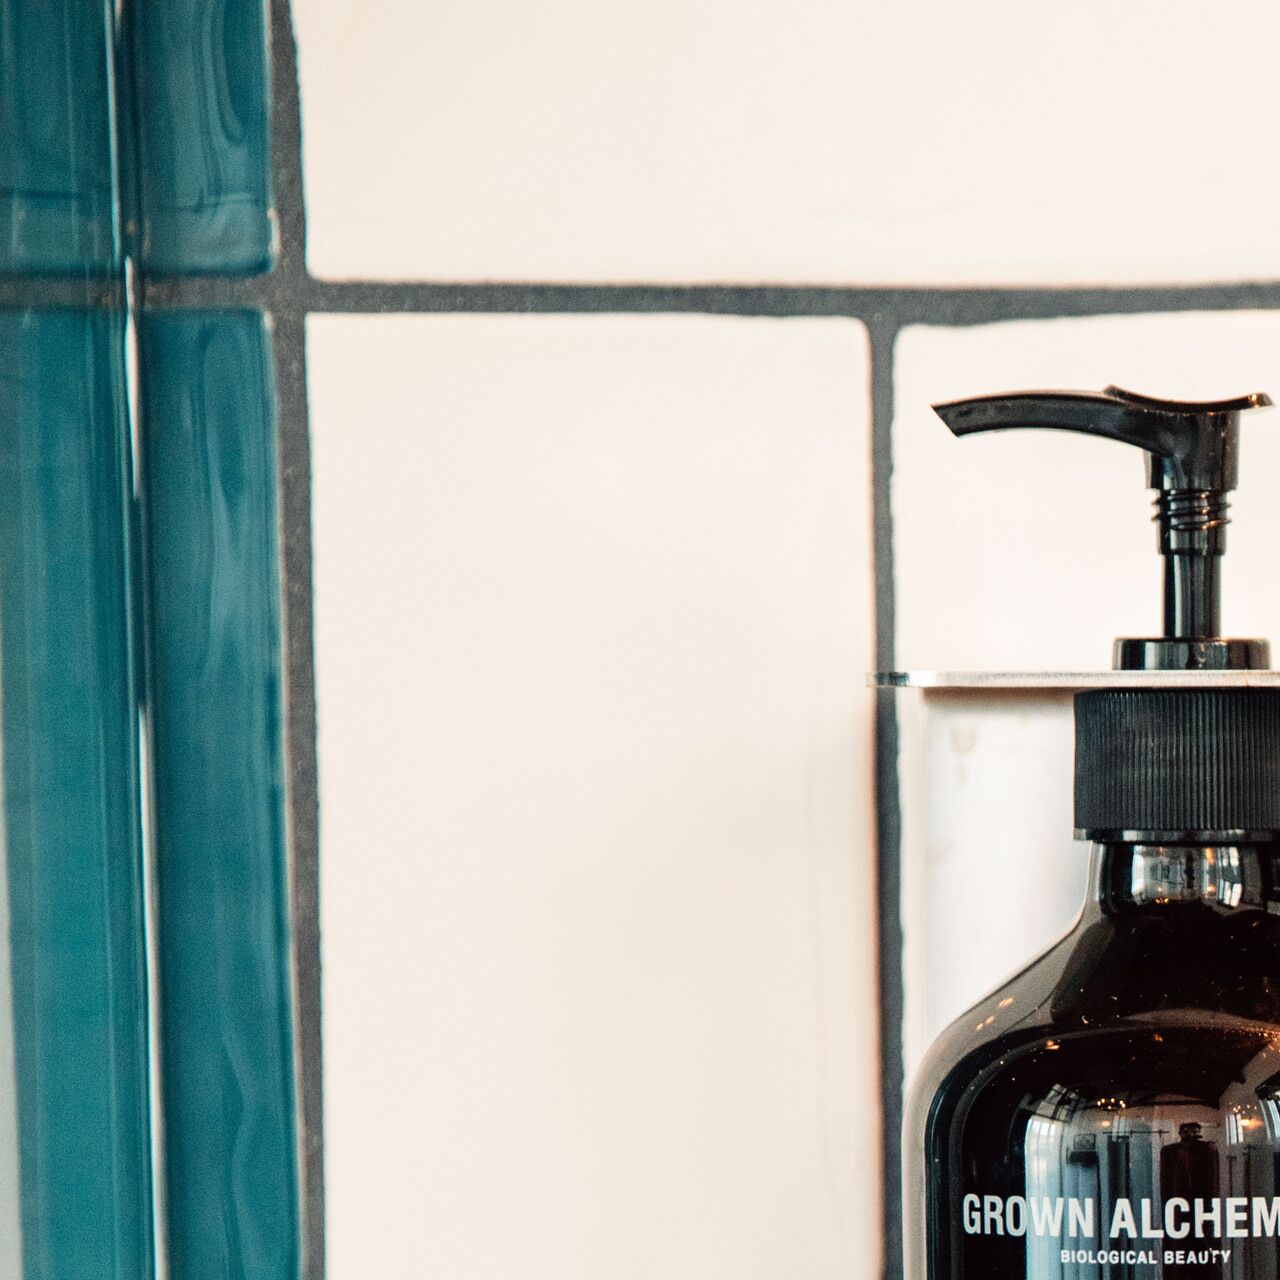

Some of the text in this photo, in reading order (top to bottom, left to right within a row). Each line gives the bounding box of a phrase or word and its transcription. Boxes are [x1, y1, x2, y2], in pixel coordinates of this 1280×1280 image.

[963, 1194, 1094, 1238] GROWN
[1061, 1250, 1231, 1264] BIOLOGICAL BEAUTY
